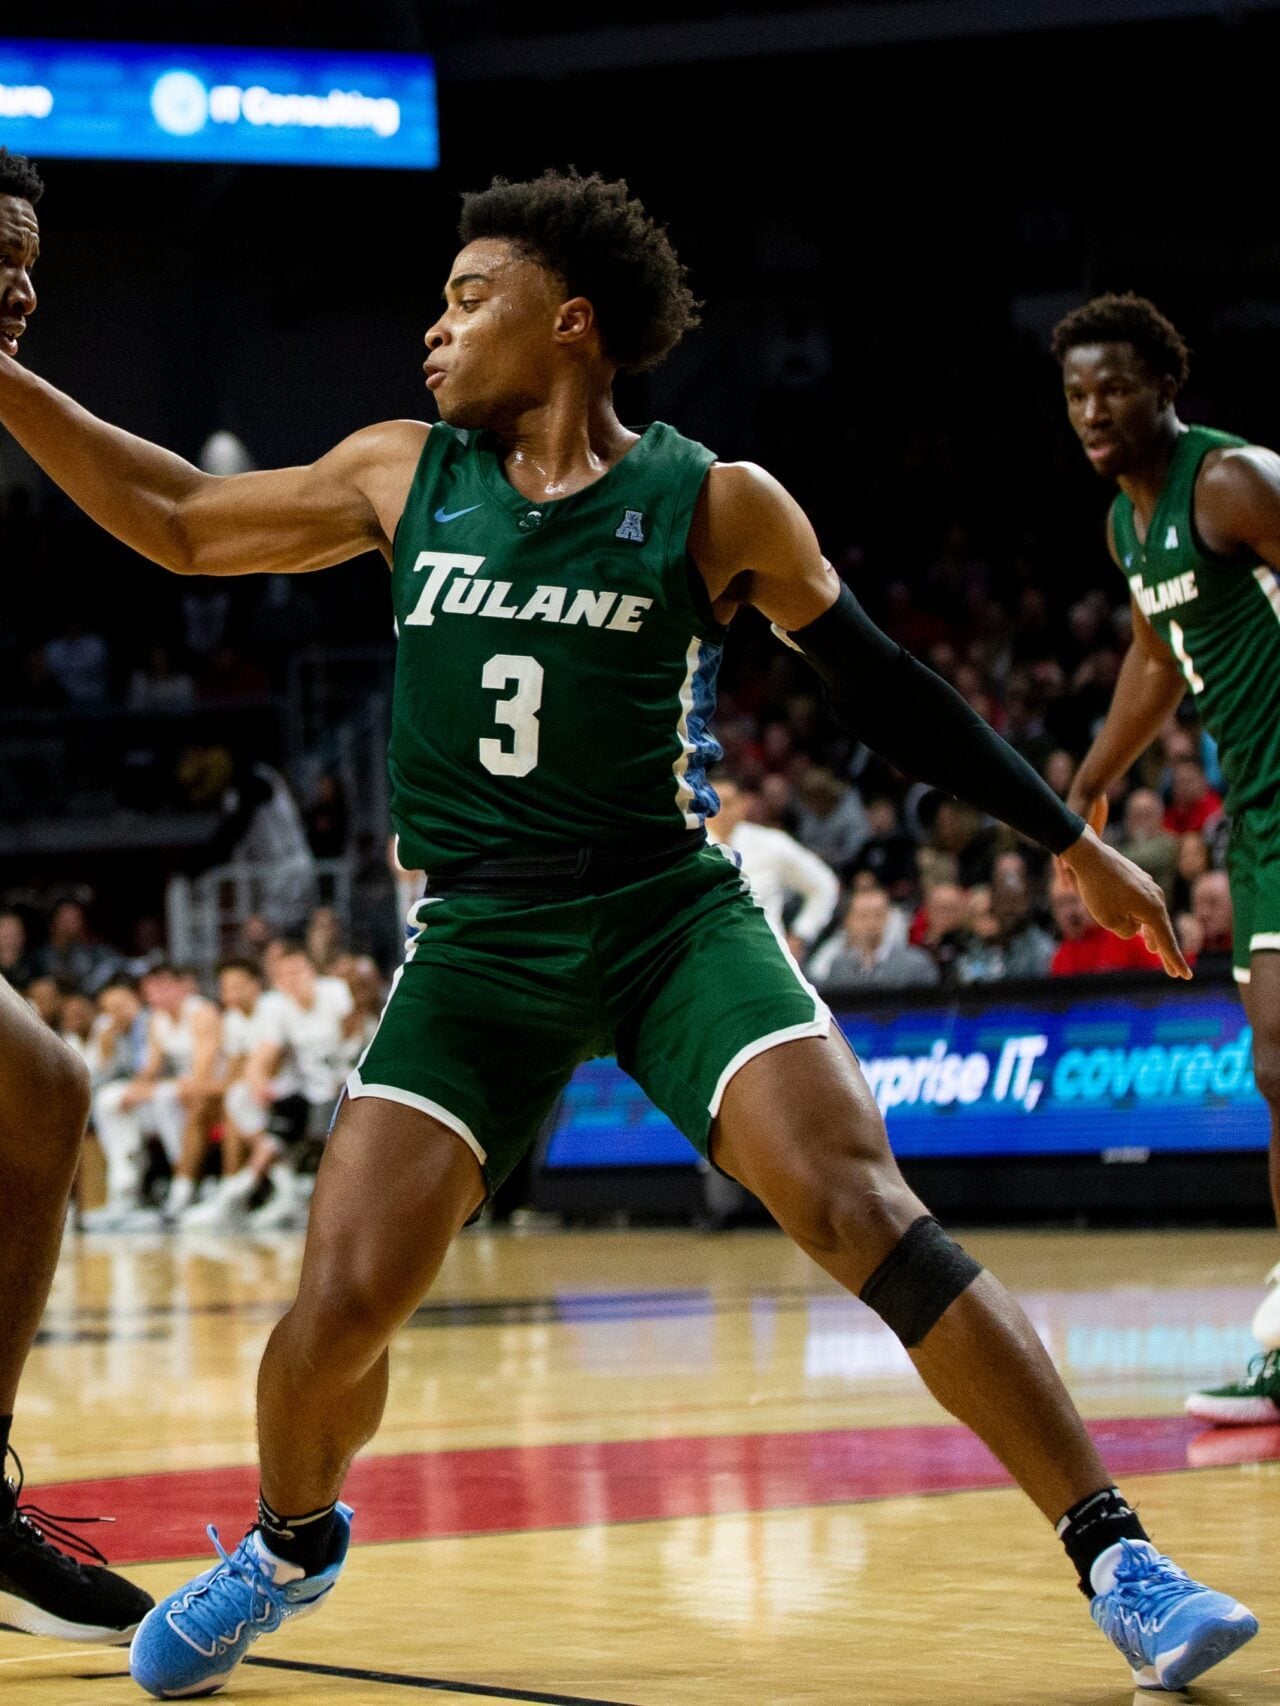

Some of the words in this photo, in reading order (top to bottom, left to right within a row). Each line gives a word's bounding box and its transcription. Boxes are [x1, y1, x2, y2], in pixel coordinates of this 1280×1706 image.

[210, 86, 241, 122] IT
[243, 88, 399, 135] Consulting
[404, 551, 654, 632] TULANE
[479, 654, 544, 777] 3
[859, 1038, 990, 1120] rprise
[992, 1034, 1049, 1113] IT,
